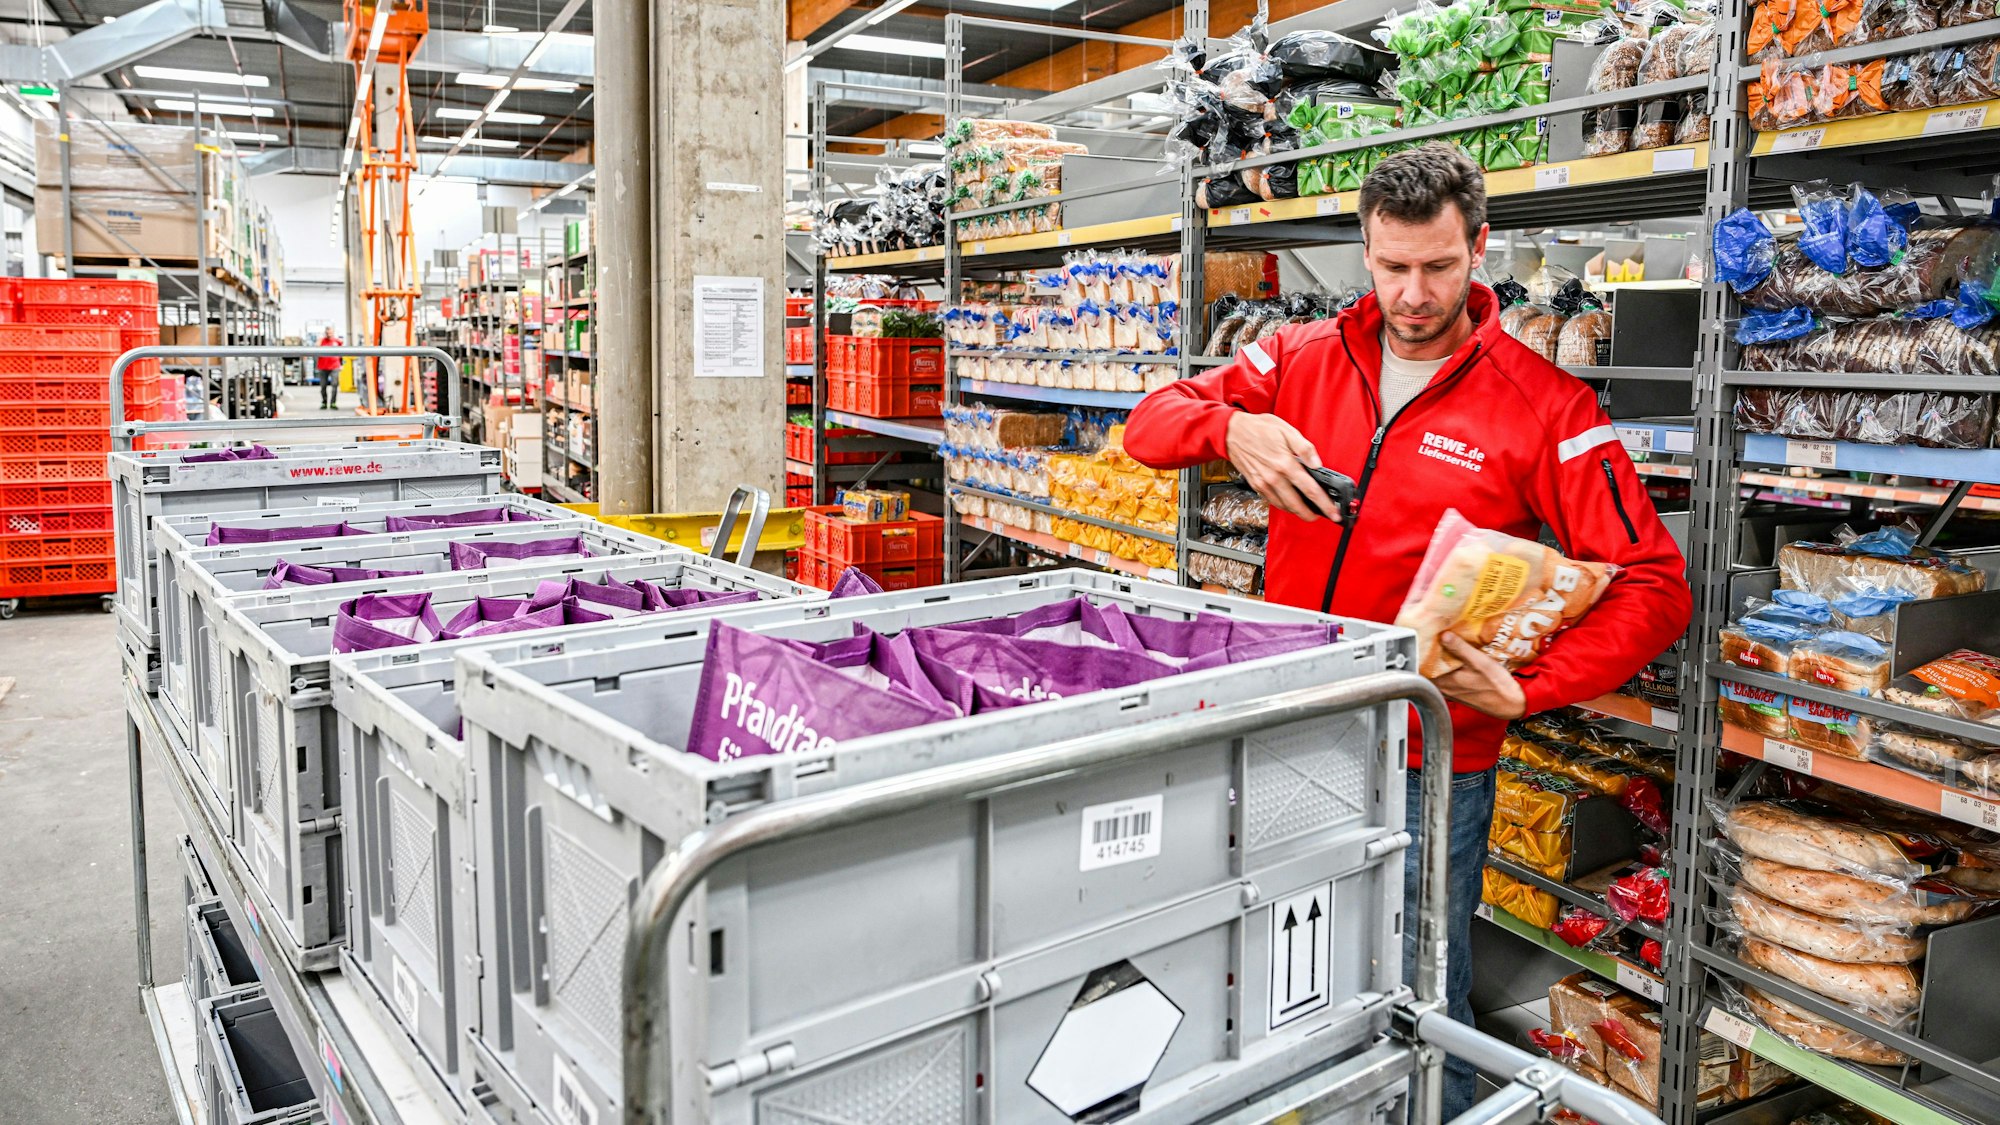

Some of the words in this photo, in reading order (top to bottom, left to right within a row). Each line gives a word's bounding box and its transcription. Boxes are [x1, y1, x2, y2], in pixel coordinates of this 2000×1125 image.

[1422, 431, 1486, 462] REWE.de
[1418, 444, 1482, 473] Lieferservice
[290, 461, 383, 478] www.rewe.de
[1740, 652, 1759, 666] Harry
[1816, 671, 1836, 684] Harry
[1926, 667, 1949, 683] Stück
[1988, 804, 1996, 812] 02
[1096, 838, 1145, 858] 414745
